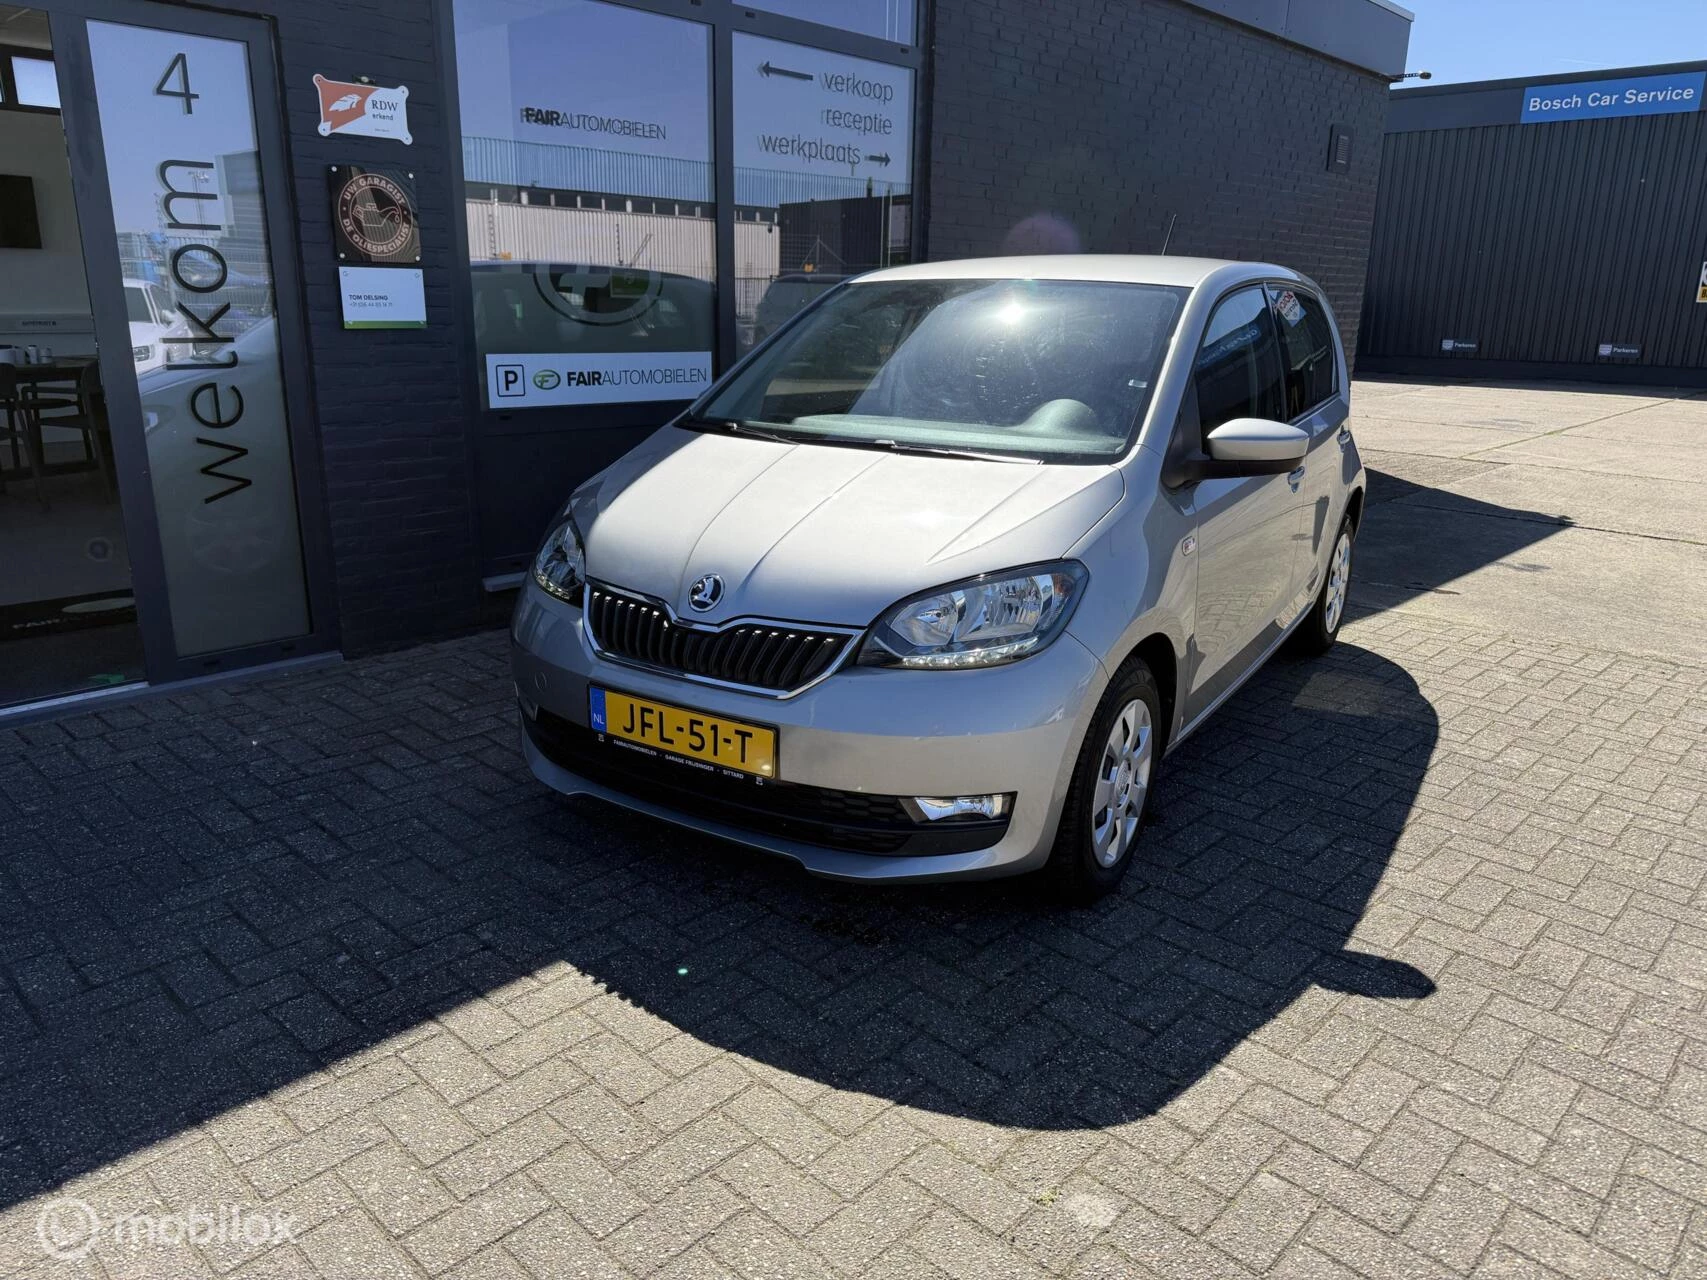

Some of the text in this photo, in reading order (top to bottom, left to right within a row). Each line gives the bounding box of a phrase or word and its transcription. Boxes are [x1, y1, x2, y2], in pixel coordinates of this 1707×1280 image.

[823, 72, 893, 104] verkoop
[1528, 86, 1695, 112] Bosch Car Service
[371, 99, 399, 111] RDW
[372, 112, 394, 121] erkend
[523, 107, 667, 140] FAIRAUTOMOBIELEN
[825, 108, 893, 136] receptie
[761, 134, 861, 164] werkplaats
[344, 176, 406, 204] UW GARAGIST
[343, 218, 410, 252] DE OLIESPECIALIST
[154, 52, 253, 505] welkom 4
[504, 370, 519, 391] P
[566, 368, 707, 387] FAIRAUTOMOBIELEN
[593, 713, 604, 725] NL
[622, 703, 753, 764] JFL-51-T
[664, 754, 685, 764] GARAGE
